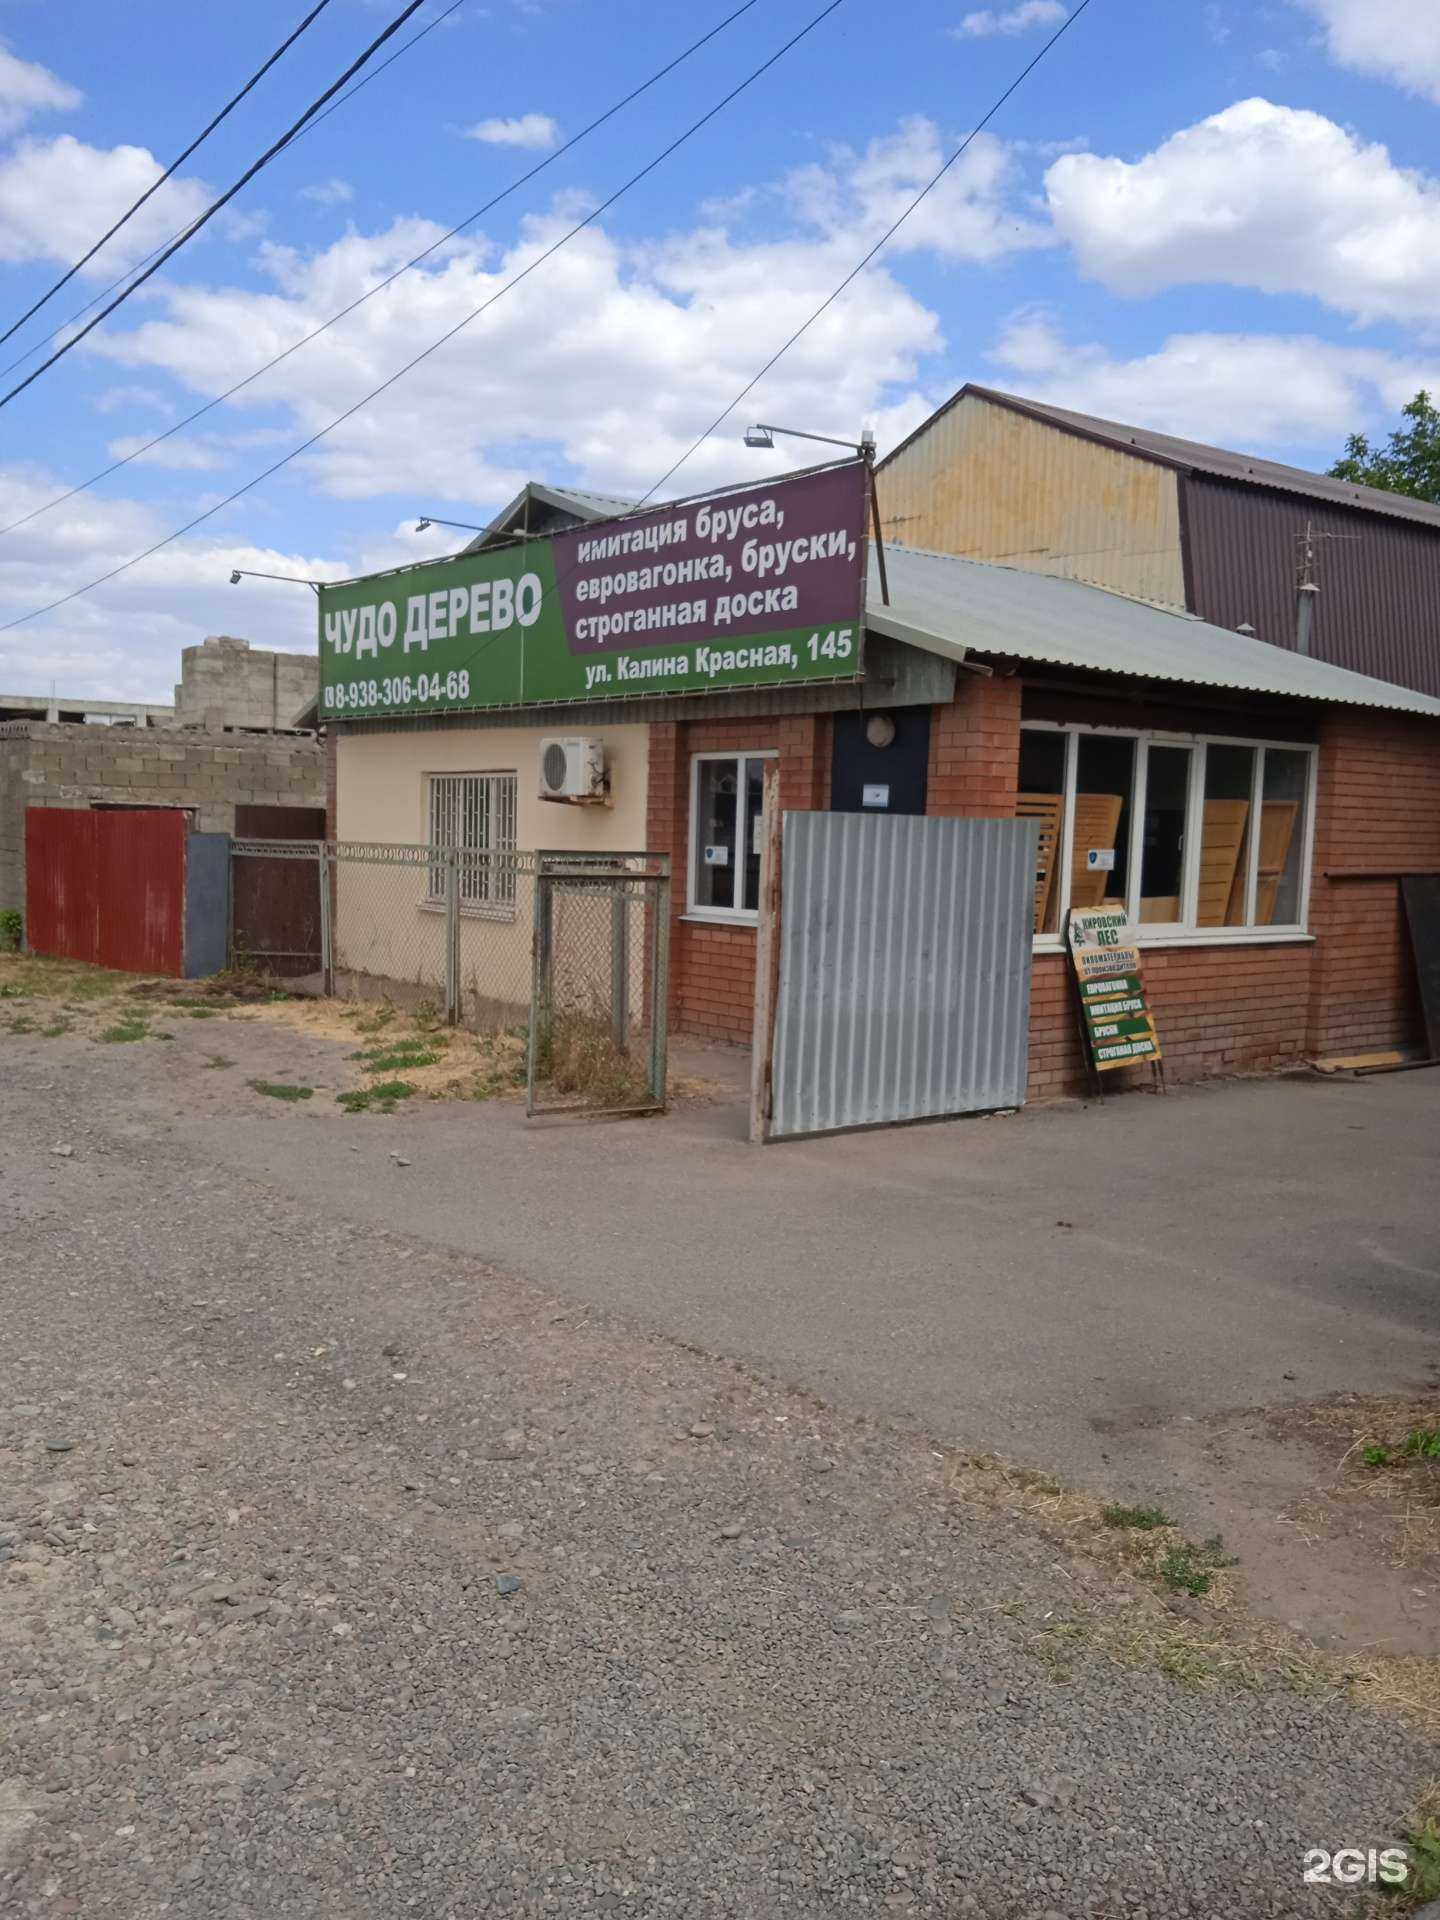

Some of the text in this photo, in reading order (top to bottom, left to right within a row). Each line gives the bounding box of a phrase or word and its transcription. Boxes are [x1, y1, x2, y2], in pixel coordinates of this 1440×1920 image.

[577, 499, 784, 564] имитация бруса,
[576, 529, 856, 604] евровагонка, бруски,
[324, 572, 543, 660] ЧУДО ДЕРЕВО
[575, 584, 798, 643] строганная доска
[335, 669, 470, 709] 8-938-306-04-68
[585, 629, 853, 690] ул. Калина Красная, 145
[1082, 914, 1127, 930] КИРОВСКИЙ
[1097, 930, 1119, 946] ЛЕС
